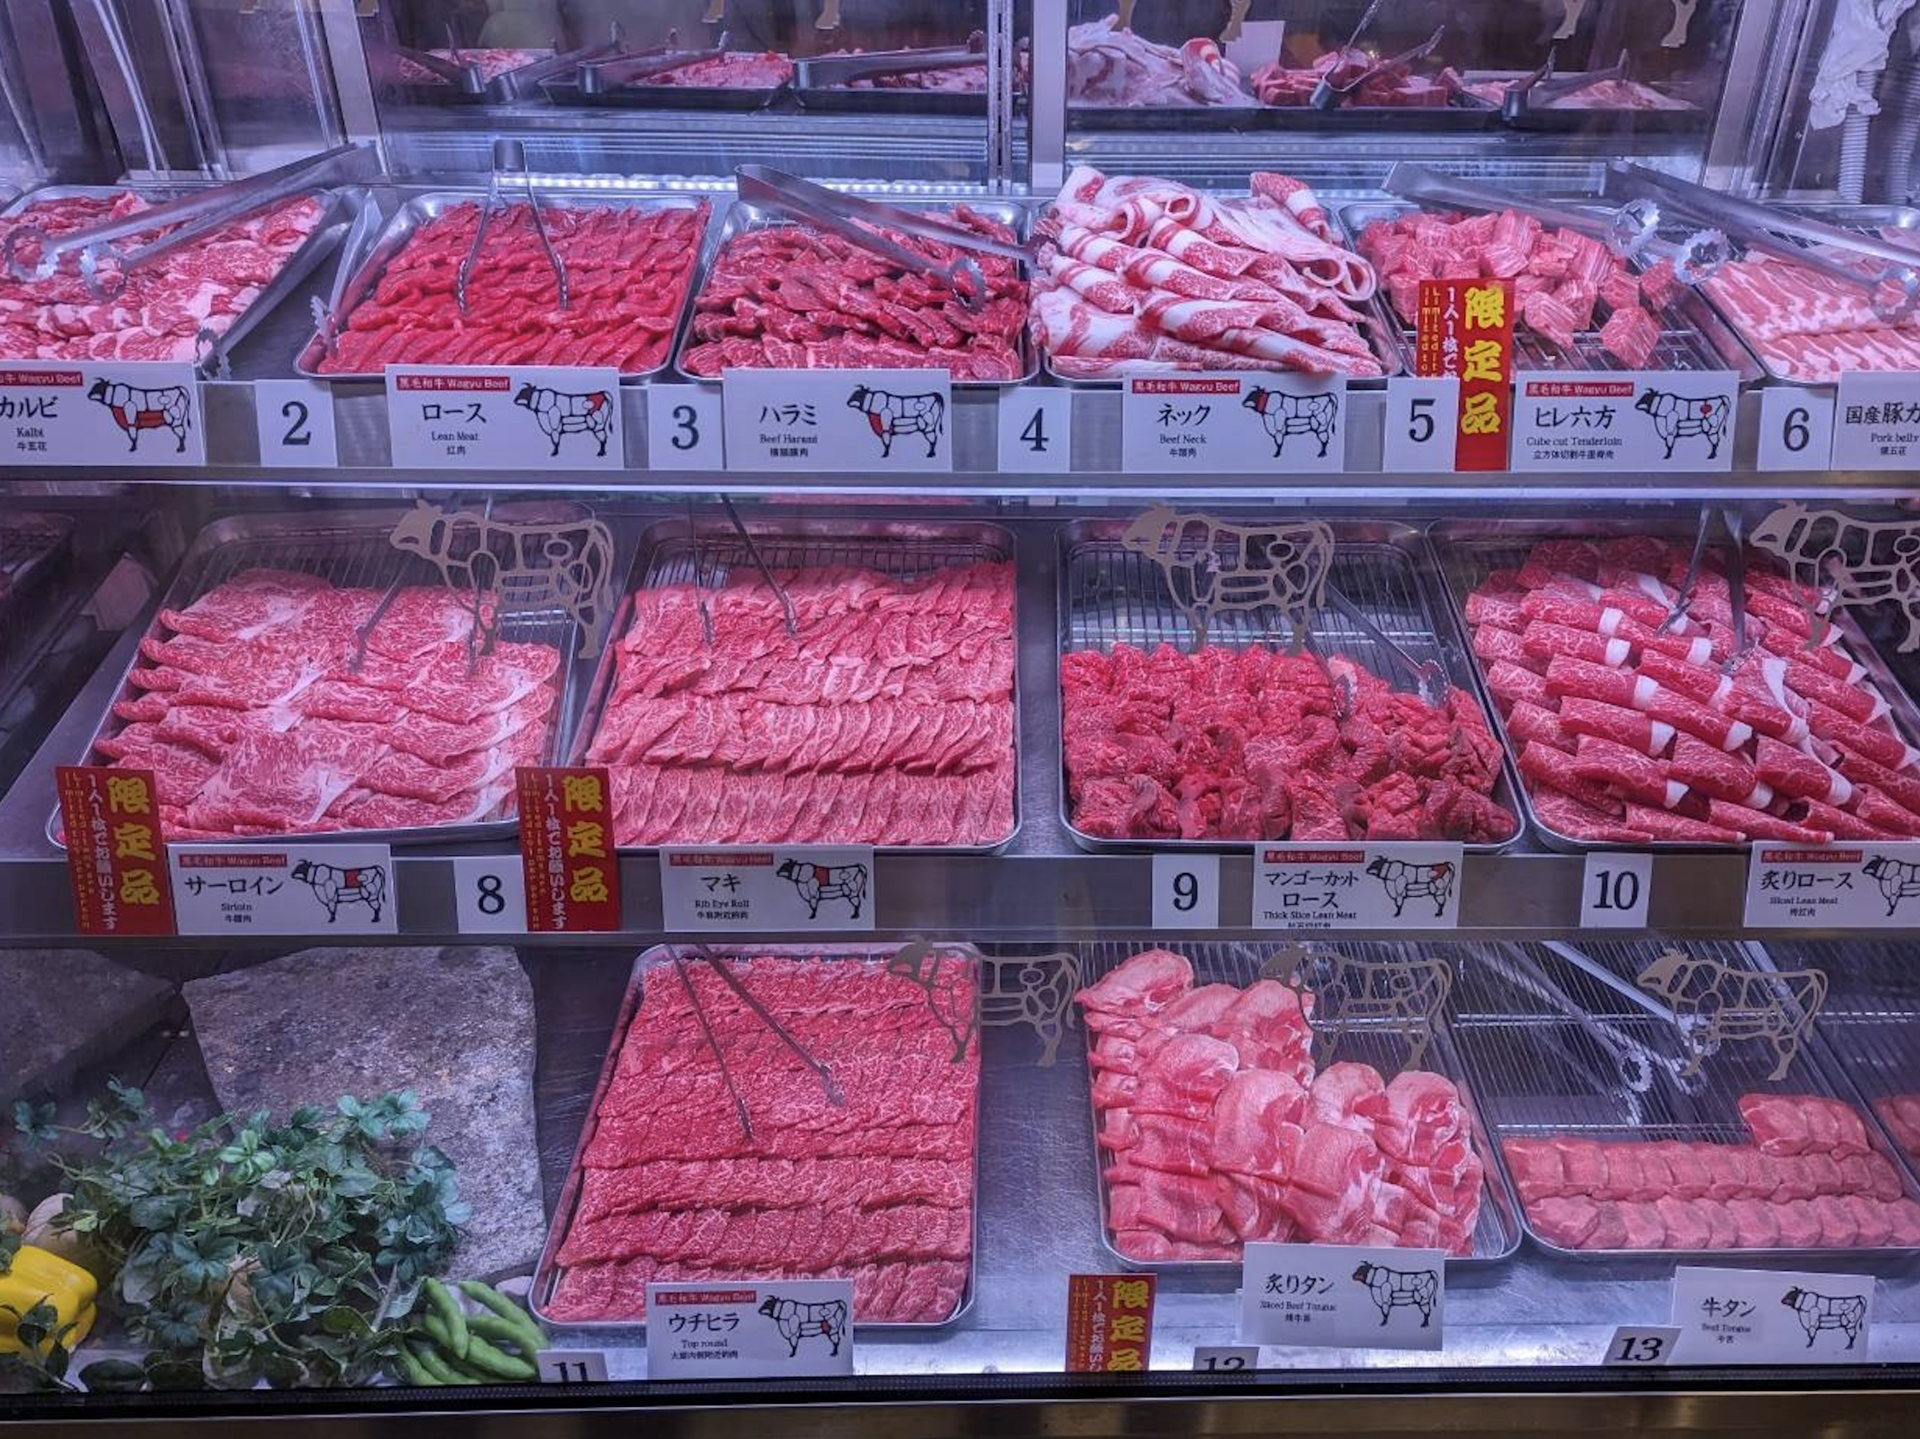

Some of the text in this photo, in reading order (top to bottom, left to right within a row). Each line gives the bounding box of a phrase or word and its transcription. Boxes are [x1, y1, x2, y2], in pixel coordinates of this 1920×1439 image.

[1461, 286, 1504, 435] 限定品
[484, 380, 509, 390] Beef
[1215, 382, 1239, 391] Beef
[422, 403, 486, 423] ロース
[759, 404, 817, 425] ハラミ
[1157, 403, 1210, 426] ネック
[1409, 399, 1436, 442] 5
[1536, 405, 1616, 429] ヒレ六方
[282, 402, 311, 446] 2
[671, 406, 699, 449] 3
[1020, 408, 1049, 451] 4
[1783, 407, 1810, 452] 6
[431, 431, 478, 441] Lean Meat
[760, 433, 780, 444] Beef
[1159, 434, 1207, 444] Beef Neck
[1526, 437, 1550, 446] Cube
[1553, 437, 1569, 446] cut
[1870, 432, 1920, 443] Pork belly
[107, 775, 160, 905] 限定品
[562, 775, 608, 901] 限定品
[184, 875, 284, 896] サーロイン
[701, 874, 741, 893] マキ
[1265, 869, 1359, 887] マンゴーカット
[1761, 870, 1853, 890] 炙りロース
[477, 875, 505, 915] 8
[1172, 872, 1199, 911] 9
[1283, 892, 1338, 908] ロース
[1593, 871, 1639, 912] 10
[695, 900, 750, 908] Rib Eye Roll
[1264, 911, 1357, 920] Thick Slice Lean Meat
[1265, 1273, 1334, 1295] 炙りタン
[1701, 1297, 1756, 1318] 牛タン
[669, 1313, 740, 1333] ウチヒラ
[682, 1339, 728, 1350] Top round
[1615, 1337, 1663, 1362] 13
